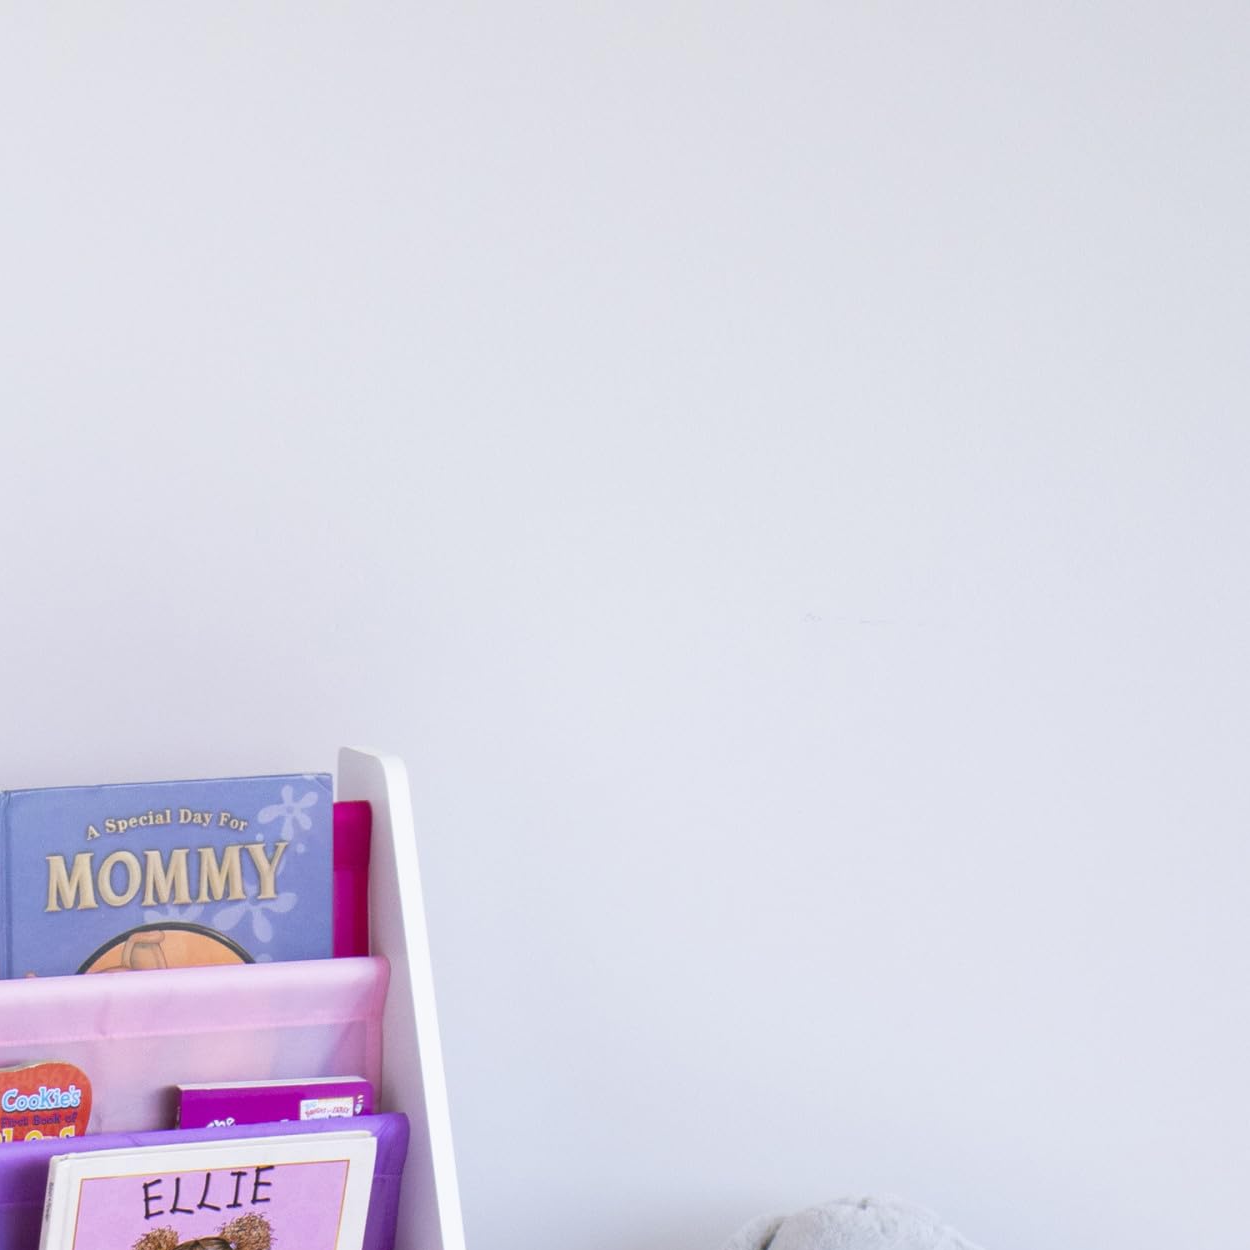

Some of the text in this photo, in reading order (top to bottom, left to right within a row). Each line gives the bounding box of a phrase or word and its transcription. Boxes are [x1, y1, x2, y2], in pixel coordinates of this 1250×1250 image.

[87, 808, 249, 841] A Special Day For
[44, 842, 289, 913] MOMMY
[143, 1165, 275, 1221] ELLIE
